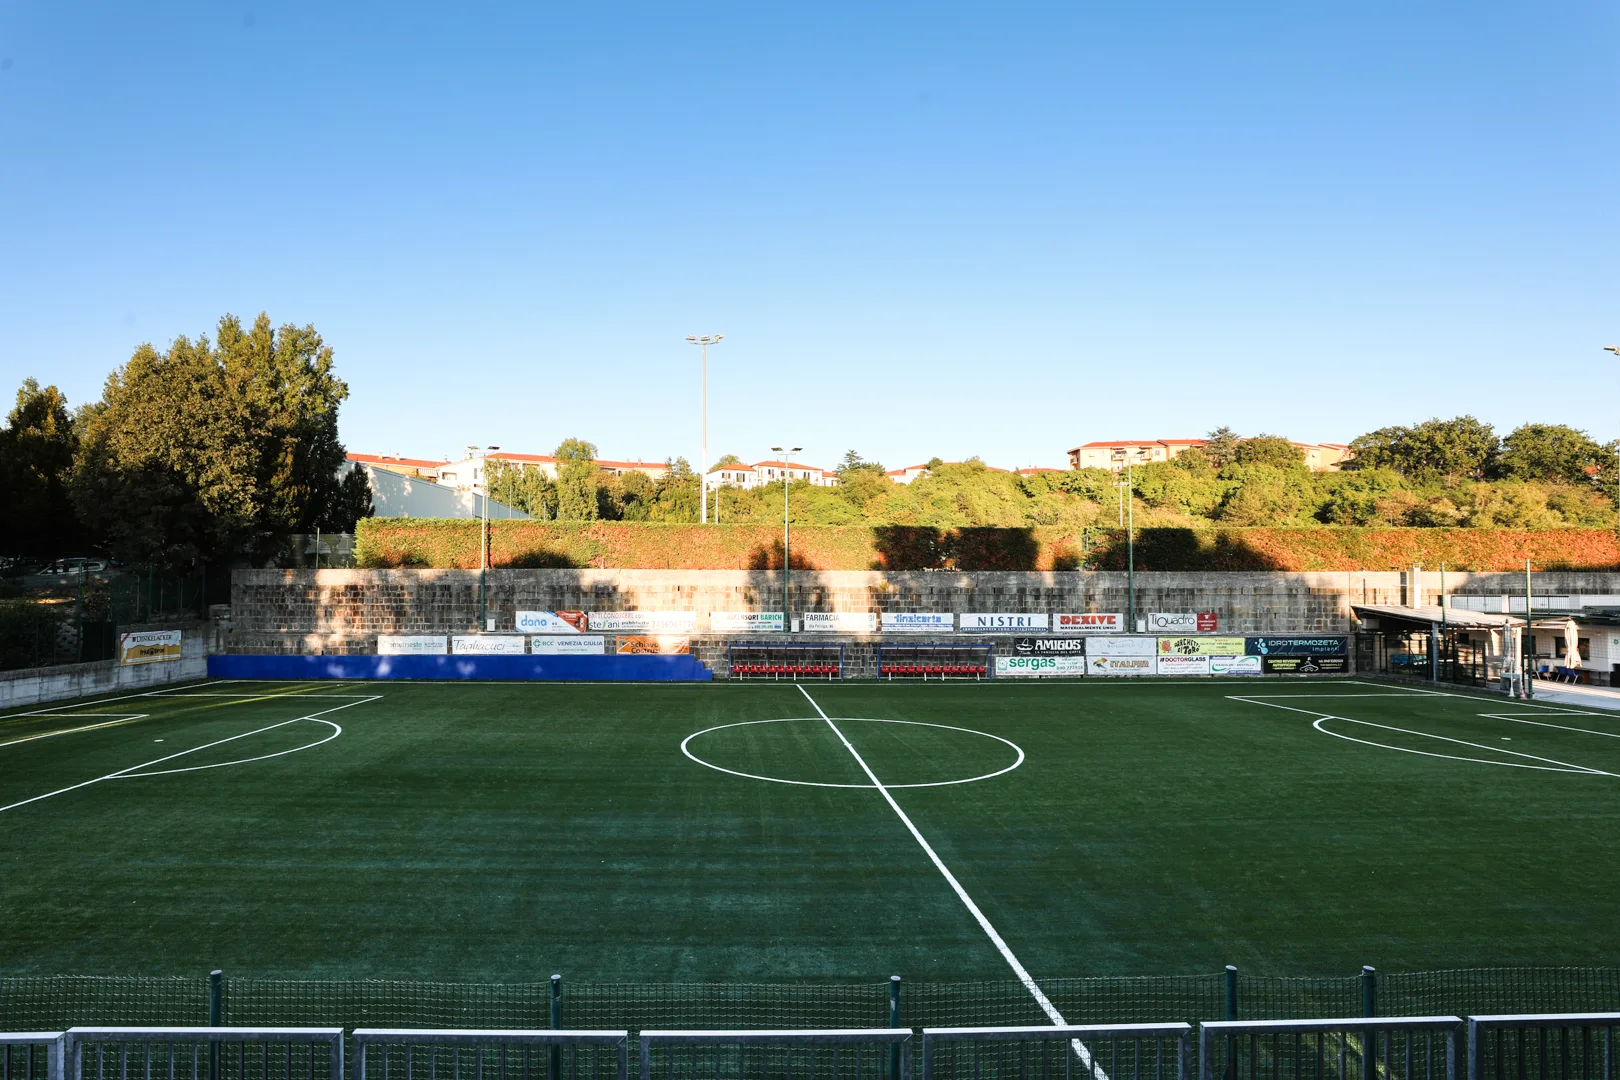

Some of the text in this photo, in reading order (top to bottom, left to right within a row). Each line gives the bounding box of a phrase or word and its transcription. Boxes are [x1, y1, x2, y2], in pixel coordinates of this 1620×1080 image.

[977, 616, 1032, 627] NISTRI
[1060, 615, 1117, 625] DEXIVE
[1149, 613, 1196, 628] TiQuadro
[453, 639, 507, 653] Tagliacuci
[1034, 639, 1081, 651] AMIGOS
[1009, 657, 1057, 671] sergas
